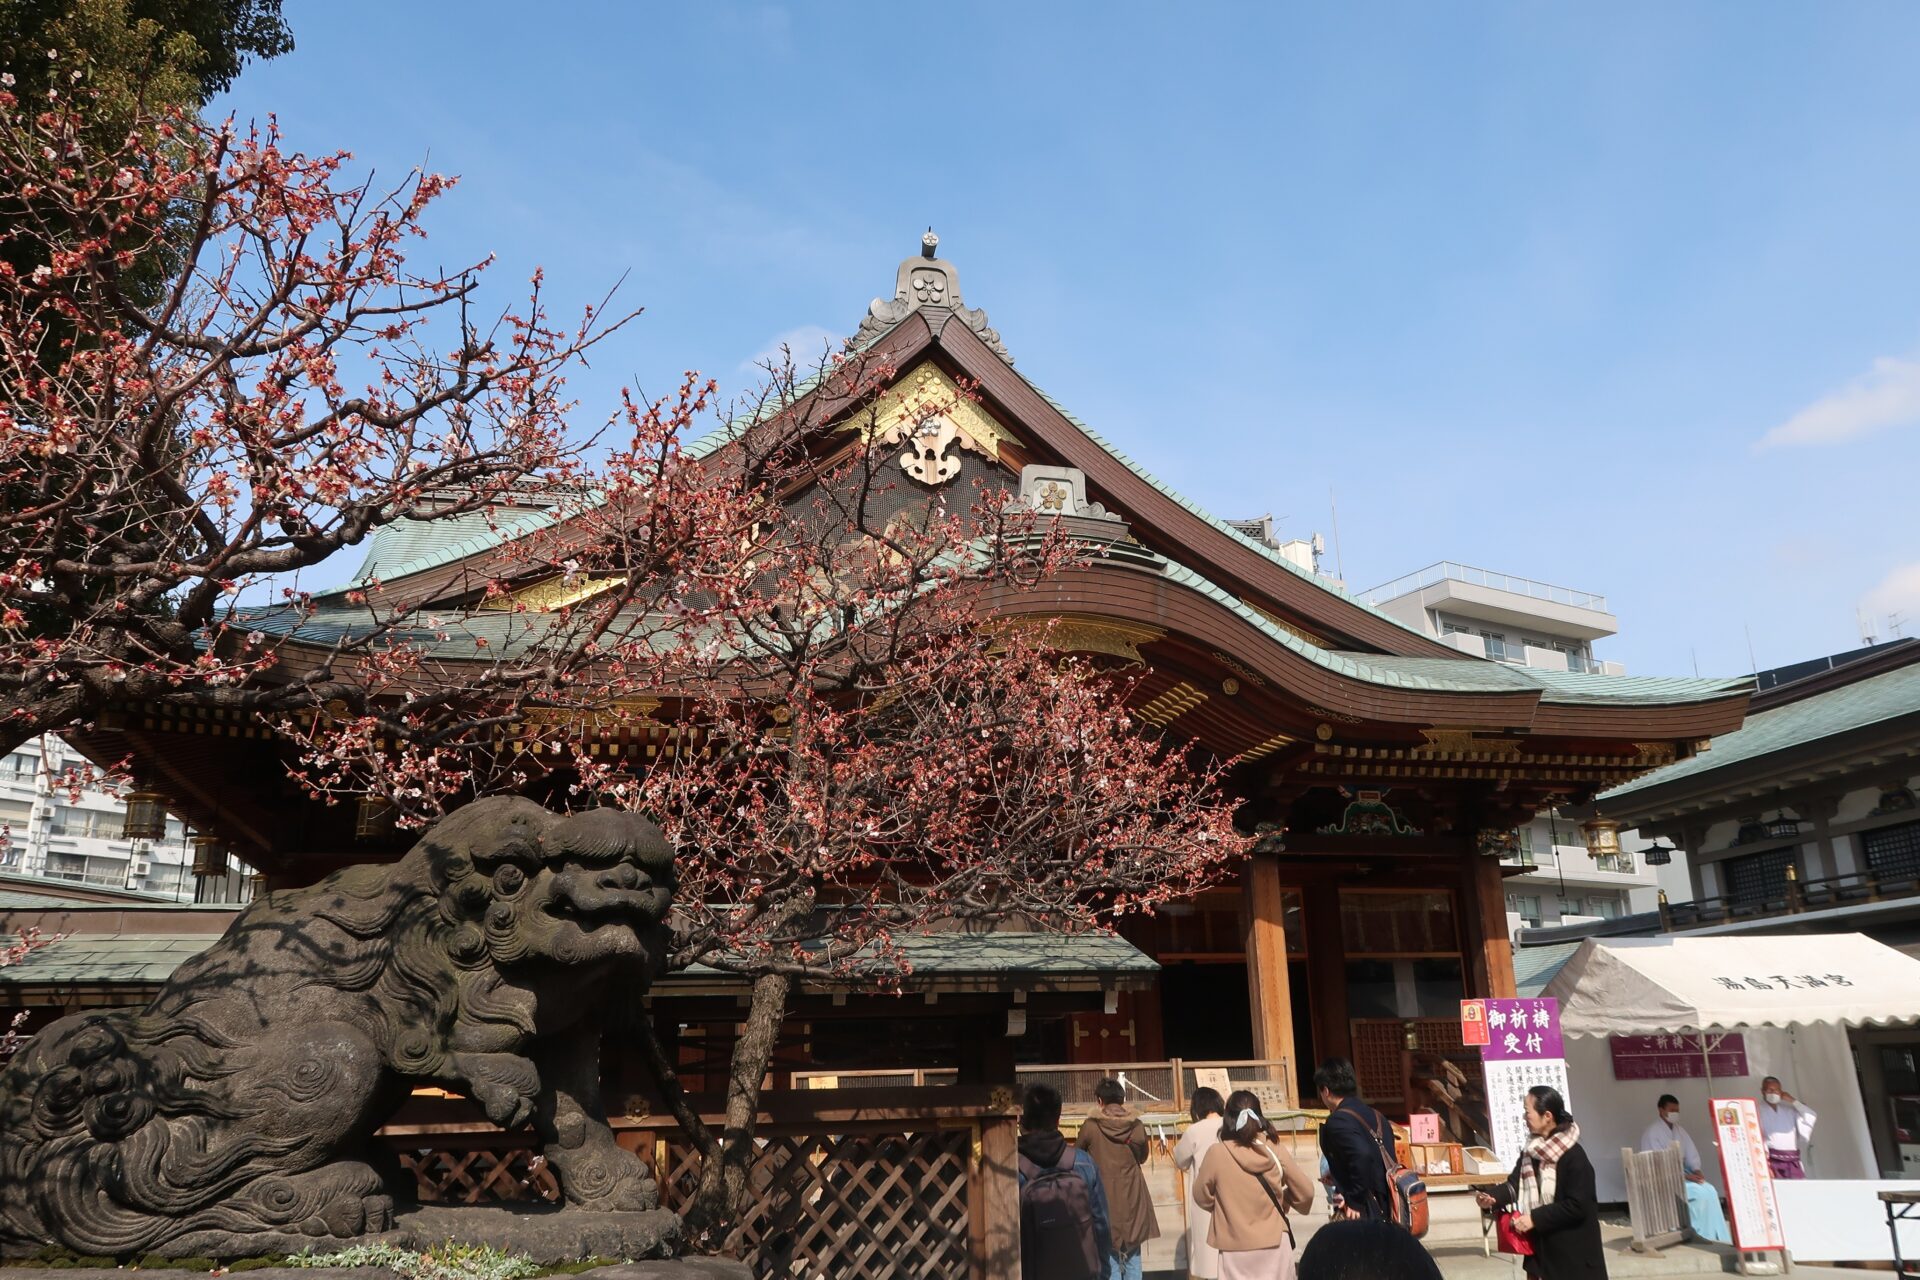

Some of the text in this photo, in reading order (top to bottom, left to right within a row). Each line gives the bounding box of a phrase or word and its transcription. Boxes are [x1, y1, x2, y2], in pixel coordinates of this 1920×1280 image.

[1711, 972, 1855, 991] 湯島天満宮
[1532, 1000, 1545, 1008] とう
[1487, 1008, 1551, 1031] 御祈祷
[1503, 1032, 1544, 1054] 受付
